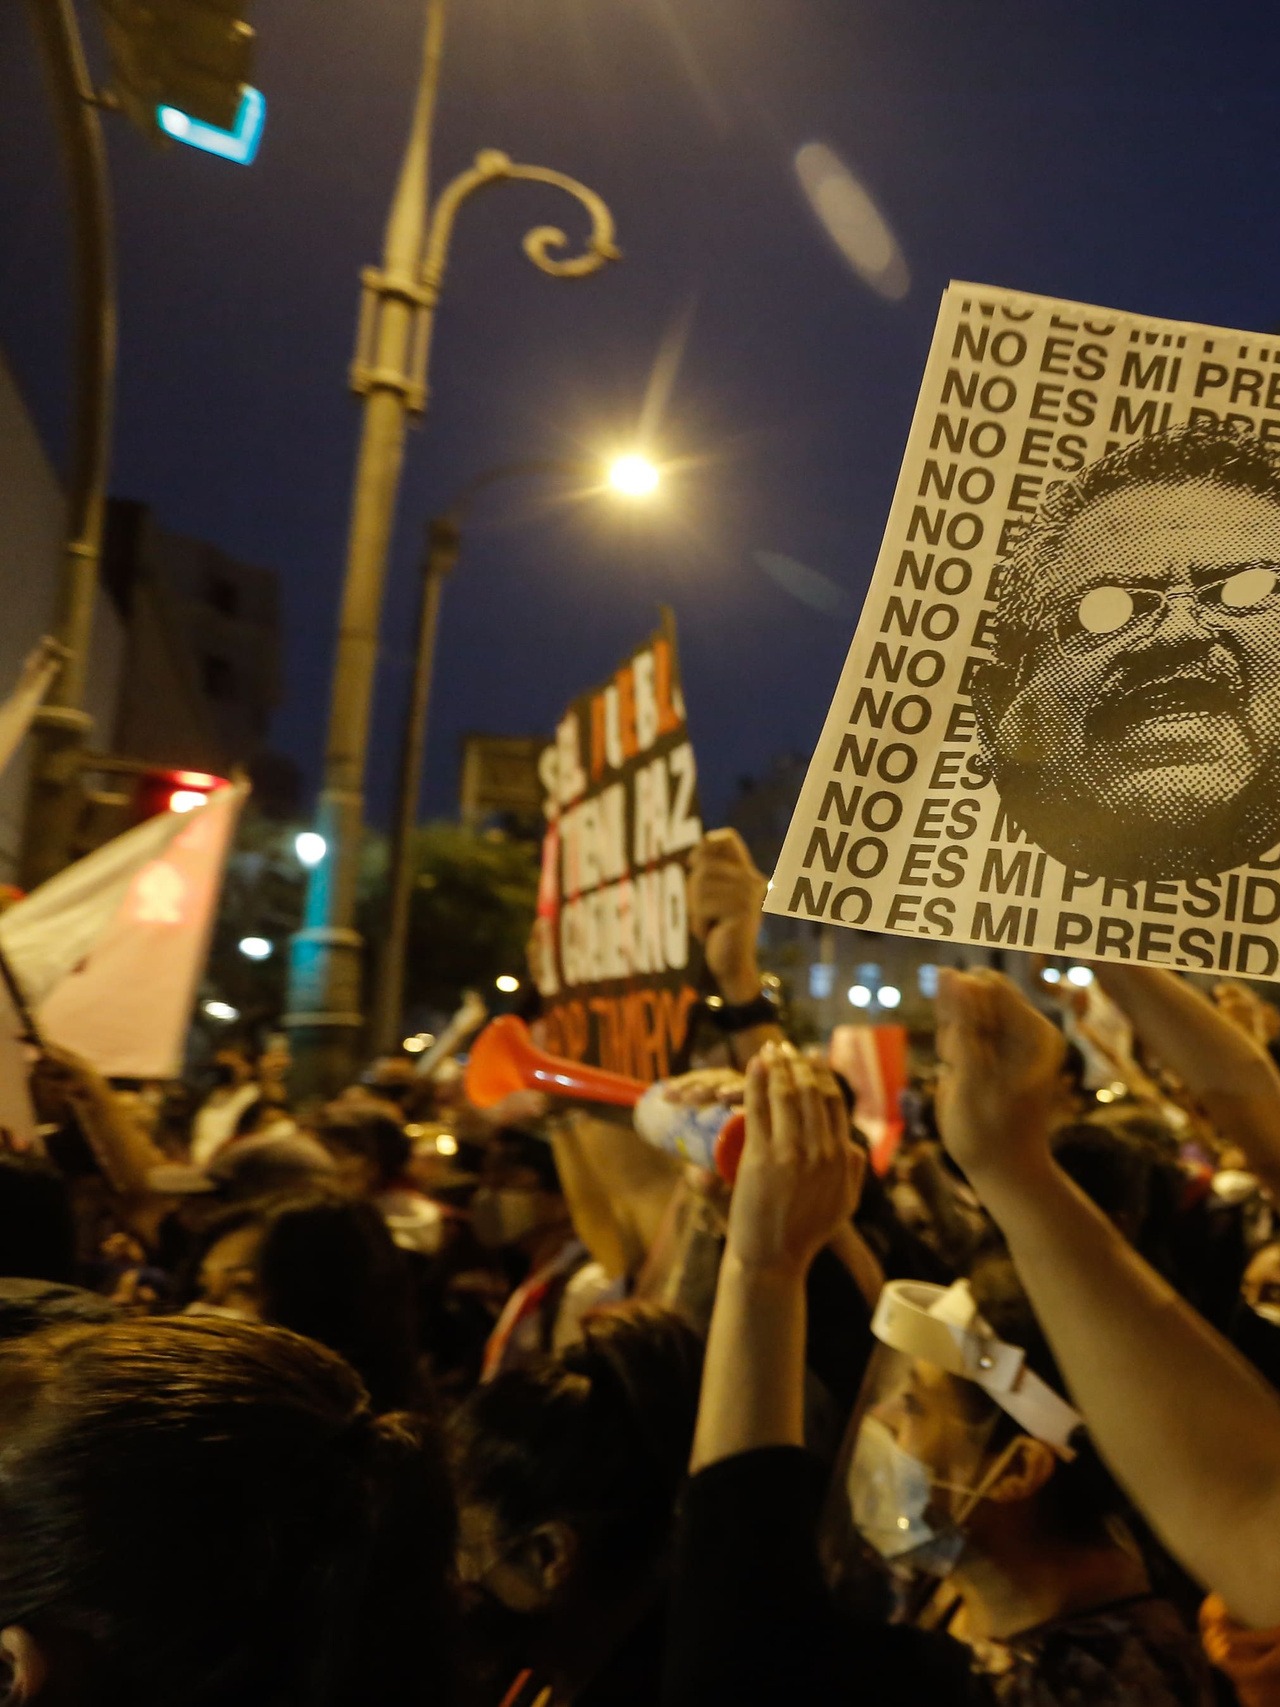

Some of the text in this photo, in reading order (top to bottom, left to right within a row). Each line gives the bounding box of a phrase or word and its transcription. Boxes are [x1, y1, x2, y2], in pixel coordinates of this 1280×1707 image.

[951, 321, 1028, 367] NO
[1040, 335, 1108, 382] ES
[1119, 351, 1182, 393] MI
[940, 366, 1018, 413] NO
[1029, 381, 1099, 427] ES
[1109, 395, 1173, 436] MI
[929, 412, 1007, 458] NO
[1019, 427, 1088, 472] ES
[917, 458, 995, 505] NO
[906, 505, 984, 550] NO
[894, 550, 973, 595] NO
[880, 596, 959, 641] NO
[865, 642, 945, 688] NO
[849, 687, 932, 735] NO
[833, 733, 992, 790] NO ES
[817, 781, 903, 832] NO
[913, 798, 981, 840] ES
[802, 827, 888, 879] NO
[898, 844, 968, 888] ES
[979, 848, 1047, 898] MI
[788, 876, 873, 924] NO
[884, 894, 956, 936] ES
[970, 902, 1038, 946] MI
